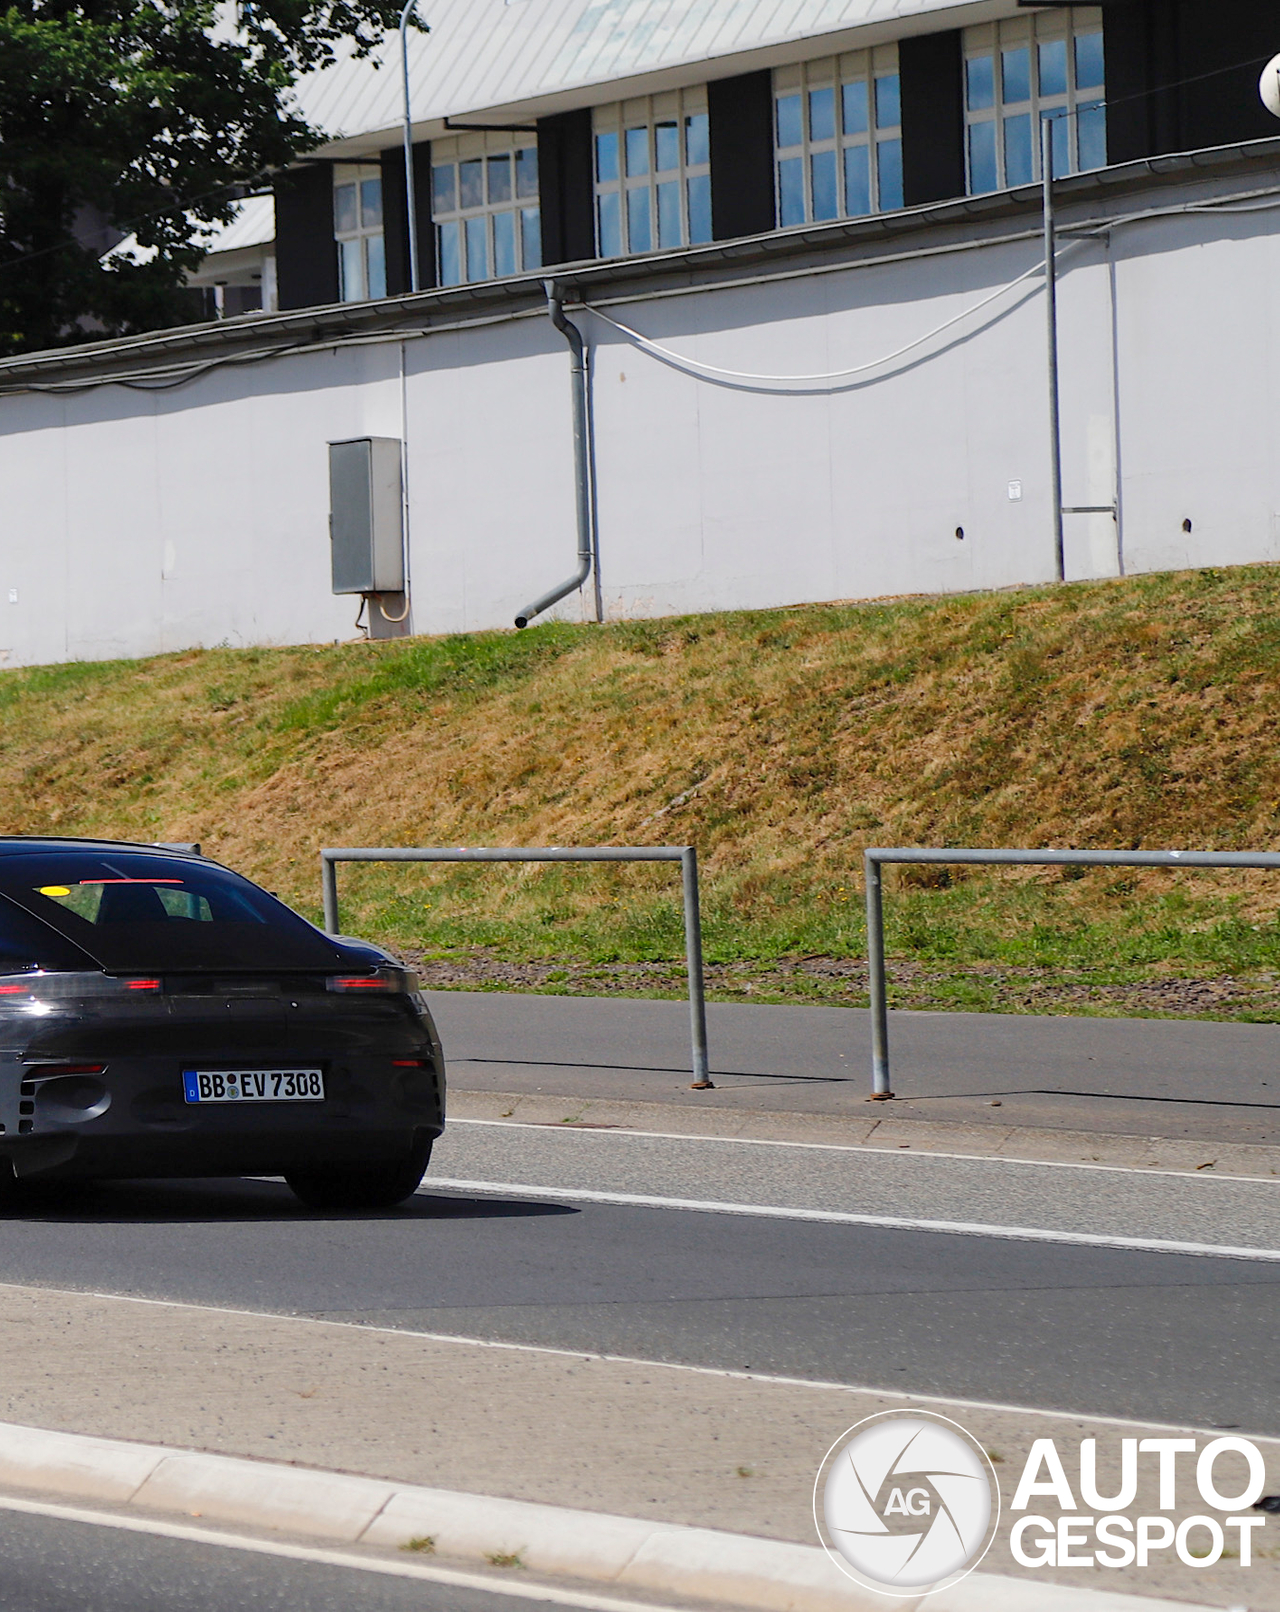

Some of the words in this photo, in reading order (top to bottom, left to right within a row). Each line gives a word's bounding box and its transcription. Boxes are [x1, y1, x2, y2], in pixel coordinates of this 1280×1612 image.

[199, 1074, 225, 1098] BB
[240, 1073, 265, 1097] EV
[270, 1072, 321, 1096] 7308
